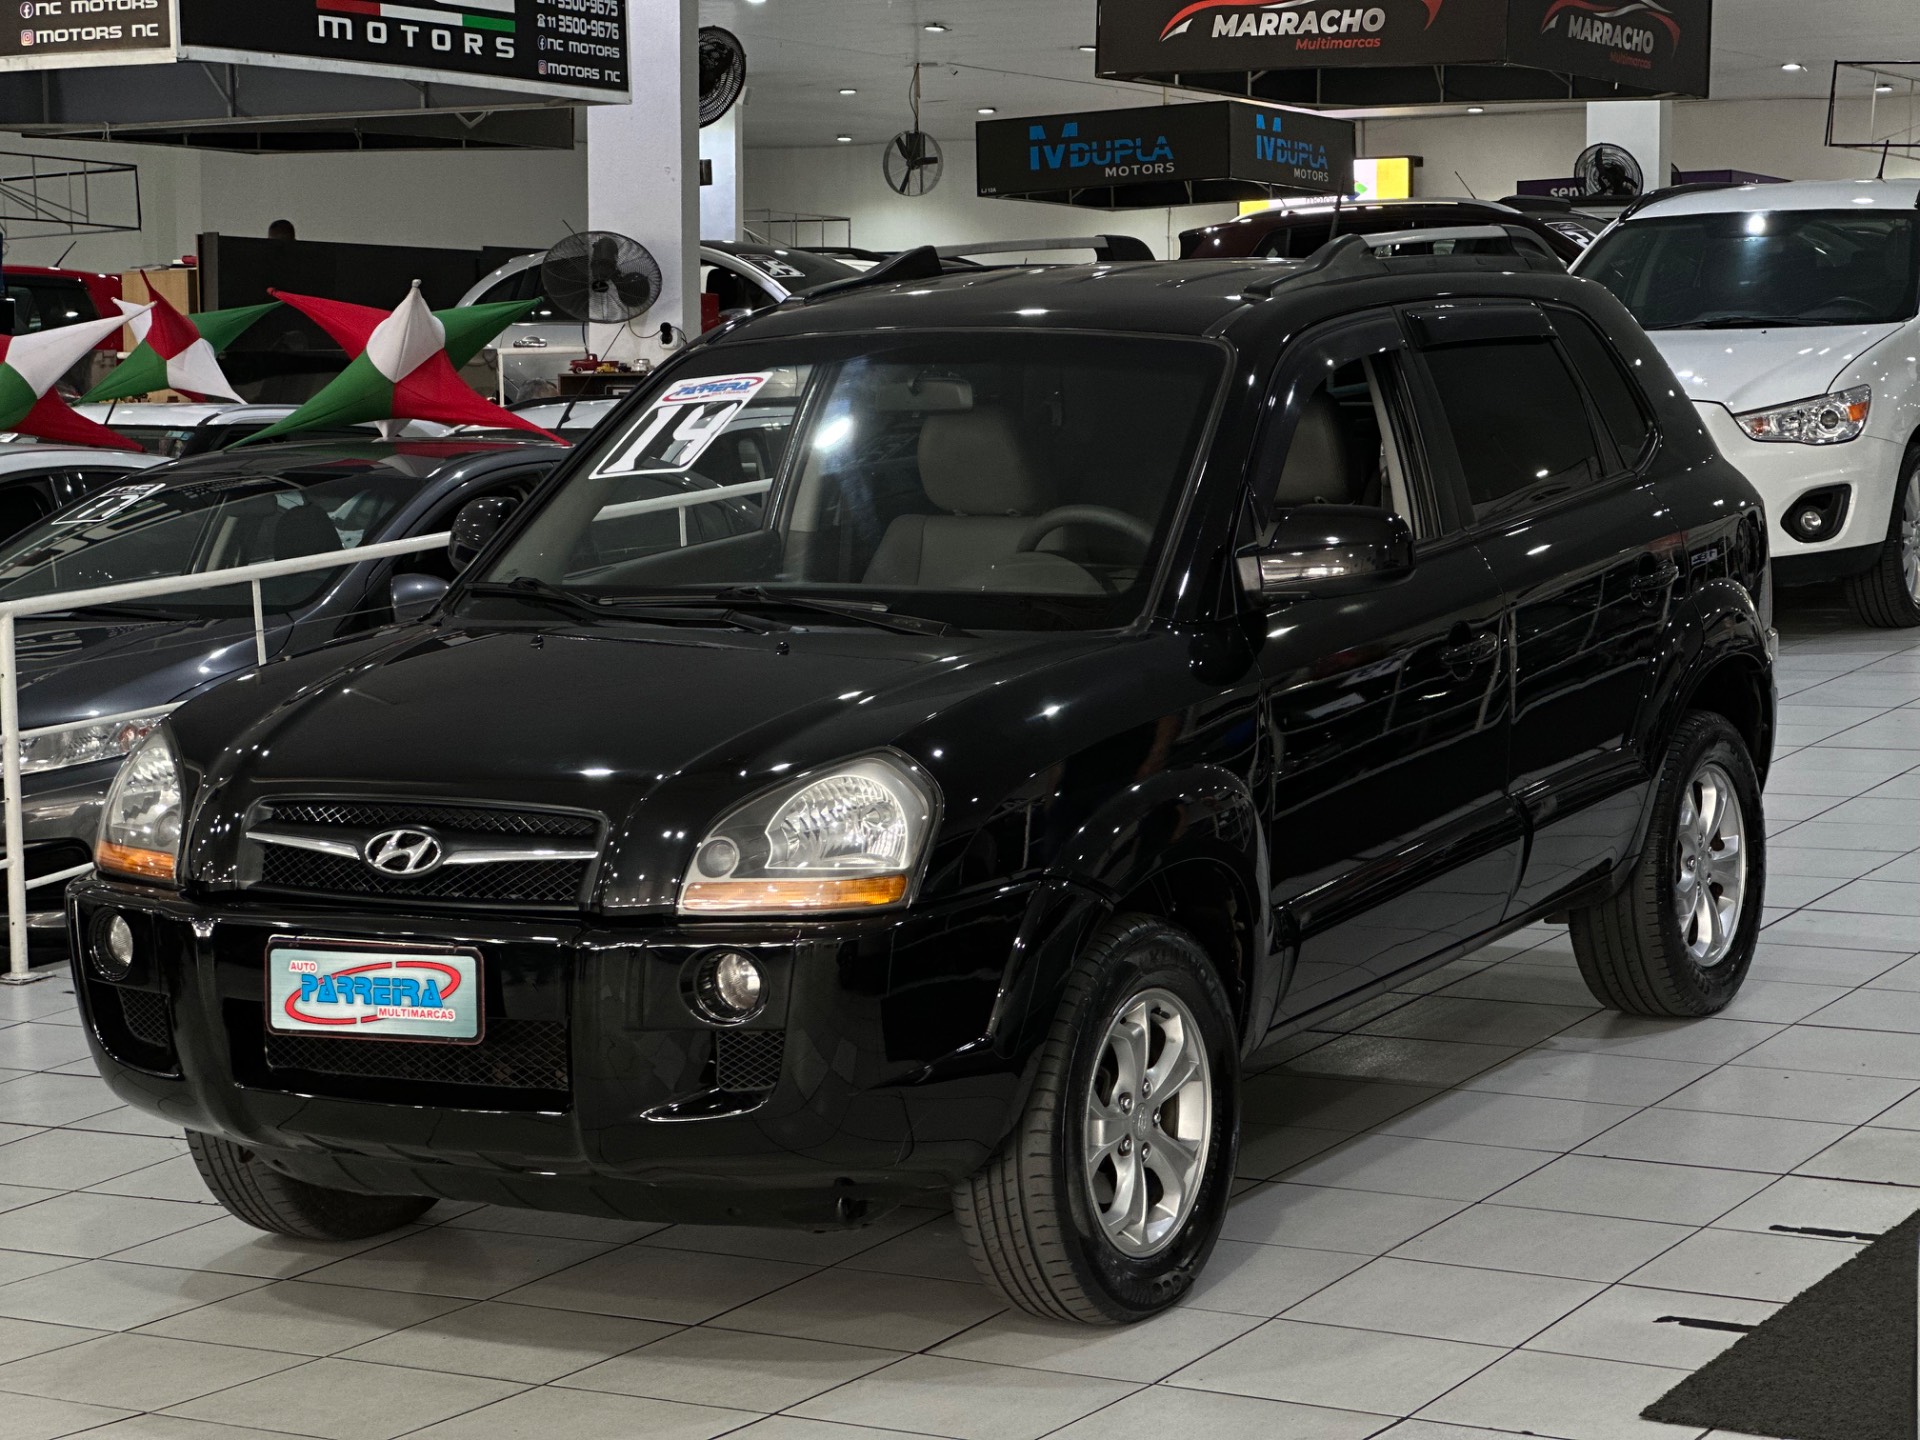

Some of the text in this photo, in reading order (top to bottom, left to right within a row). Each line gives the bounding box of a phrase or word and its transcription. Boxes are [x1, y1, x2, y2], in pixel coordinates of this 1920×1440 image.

[70, 0, 158, 13] MOTORS
[558, 14, 619, 40] 3500-9676
[1211, 7, 1386, 38] MARRACHO
[36, 23, 158, 43] MOTORS NC
[317, 14, 515, 59] MOTORS
[1567, 14, 1654, 54] MARRACHO
[547, 38, 620, 58] NC MOTORS
[1295, 37, 1381, 50] Multimarcas
[547, 62, 620, 82] MOTORS NC
[1105, 162, 1175, 177] MOTORS
[1293, 167, 1329, 182] MOTORS
[290, 961, 316, 971] AUTO
[301, 973, 443, 1008] PARREIRA
[378, 1007, 454, 1020] MULTIMARCAS
